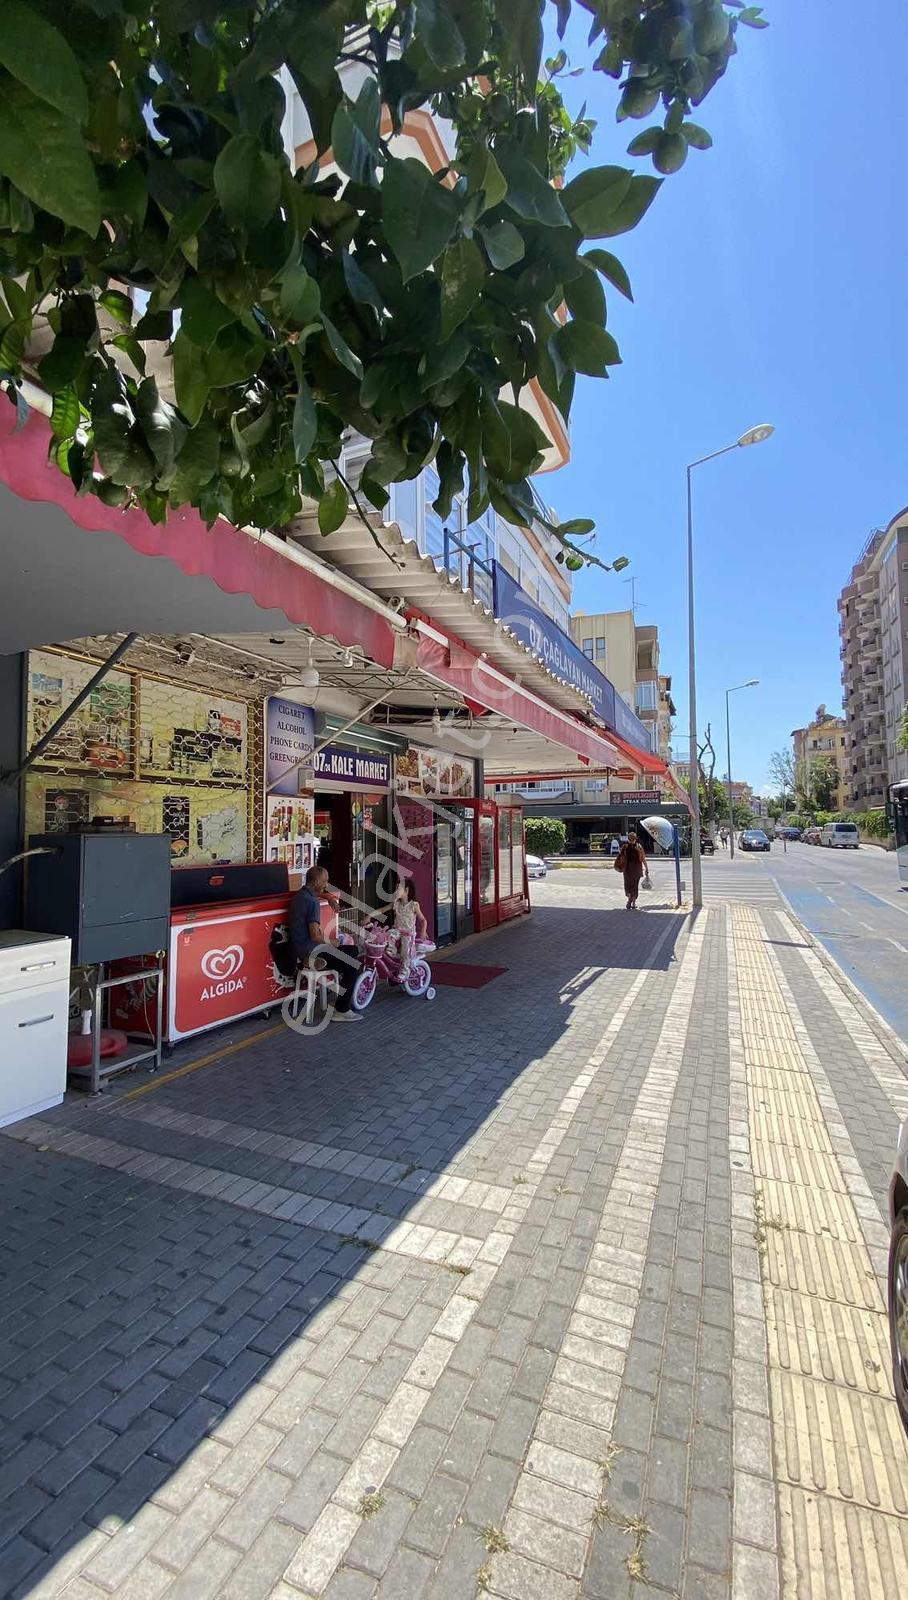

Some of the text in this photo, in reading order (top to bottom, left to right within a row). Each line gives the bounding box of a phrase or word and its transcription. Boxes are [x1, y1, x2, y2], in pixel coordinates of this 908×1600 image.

[543, 636, 581, 687] ÇAĞLAYAN
[278, 704, 305, 720] CIGARET
[277, 721, 307, 735] ALCOHOL
[270, 735, 313, 752] PHONE CARDS
[331, 754, 354, 776] KALE
[355, 759, 388, 781] MARKET
